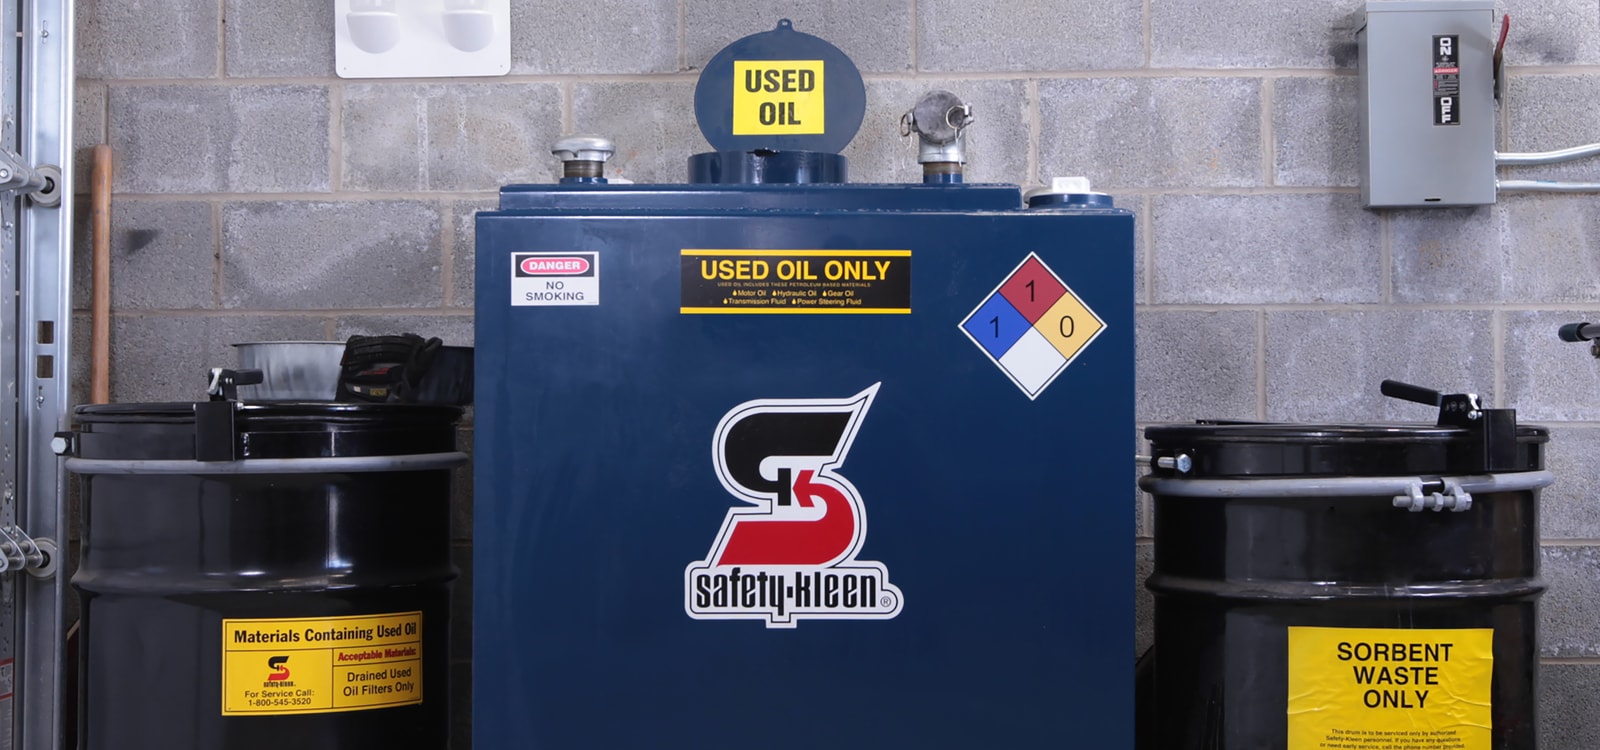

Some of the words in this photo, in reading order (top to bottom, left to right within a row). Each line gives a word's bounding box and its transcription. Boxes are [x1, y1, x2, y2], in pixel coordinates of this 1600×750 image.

[1440, 37, 1451, 55] ON
[745, 69, 815, 92] USED
[759, 101, 801, 125] OIL
[1440, 97, 1452, 123] OFF
[529, 261, 580, 270] DANGER
[701, 260, 769, 280] USED
[777, 260, 818, 280] OIL
[824, 260, 891, 280] ONLY
[546, 281, 564, 290] NO
[1025, 279, 1034, 302] 1
[526, 292, 584, 301] SMOKING
[818, 298, 845, 306] Steering
[989, 316, 999, 338] 1
[1059, 315, 1075, 338] 0
[234, 629, 300, 643] Materials
[304, 626, 373, 642] Containing
[377, 624, 402, 638] Used
[405, 622, 417, 636] Oil
[338, 651, 383, 662] Acceptable
[384, 646, 417, 659] Materials:
[1337, 641, 1453, 662] SORBENT
[347, 670, 387, 682] Drained
[390, 667, 412, 679] Used
[1353, 665, 1439, 685] WASTE
[244, 690, 259, 698] For
[261, 690, 293, 698] Service
[295, 689, 315, 697] Call:
[343, 686, 359, 697] Oil
[362, 684, 393, 696] Filters
[395, 681, 415, 693] Only
[249, 697, 312, 706] 1-800-545-3520
[1363, 689, 1429, 709] ONLY
